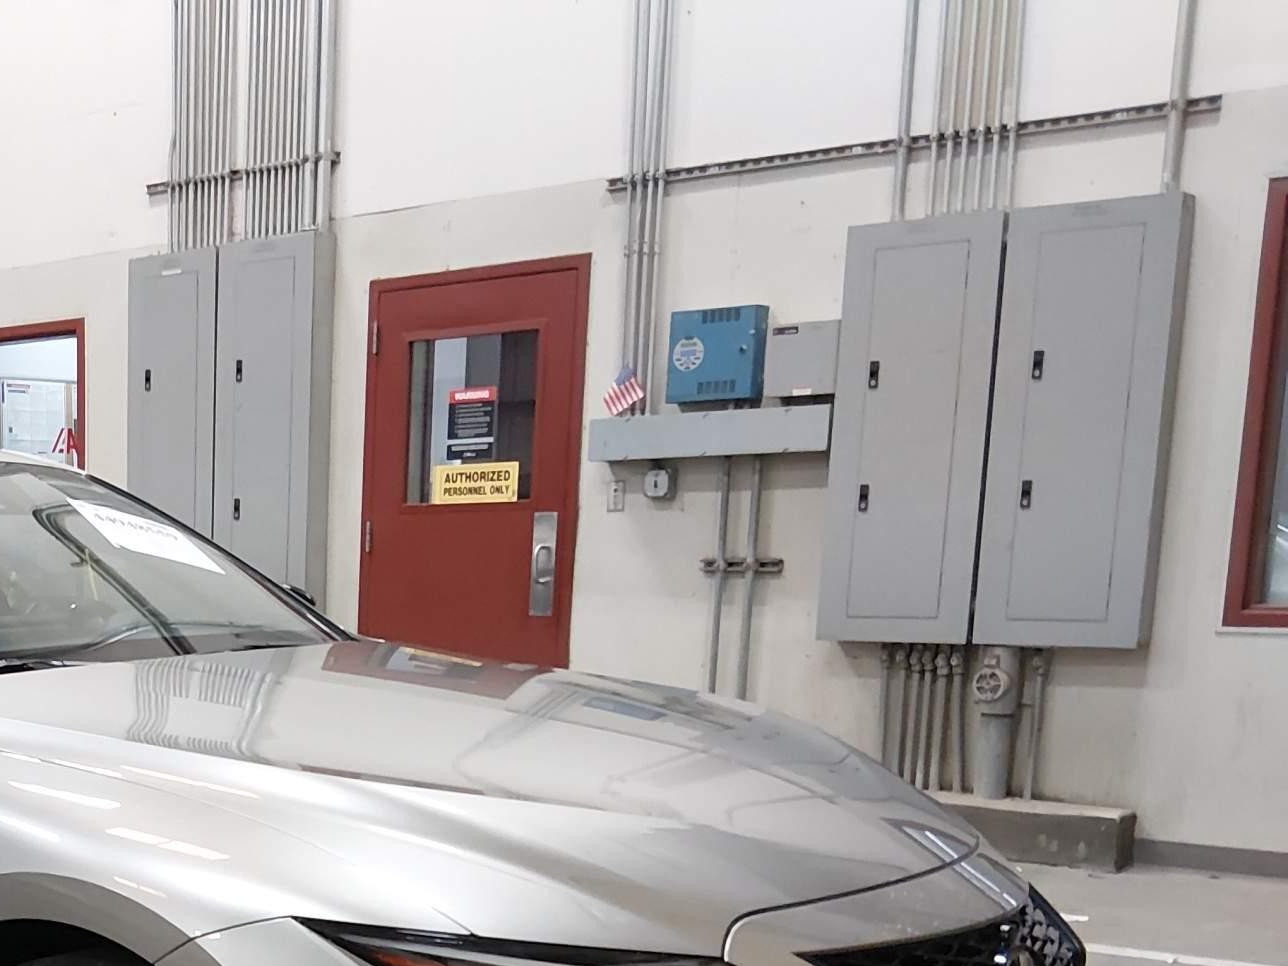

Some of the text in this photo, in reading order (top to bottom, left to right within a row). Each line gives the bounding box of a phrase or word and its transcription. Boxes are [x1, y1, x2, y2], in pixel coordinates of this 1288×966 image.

[444, 470, 511, 484] AUTHORIZED
[443, 485, 510, 497] PERSONNEL ONLY
